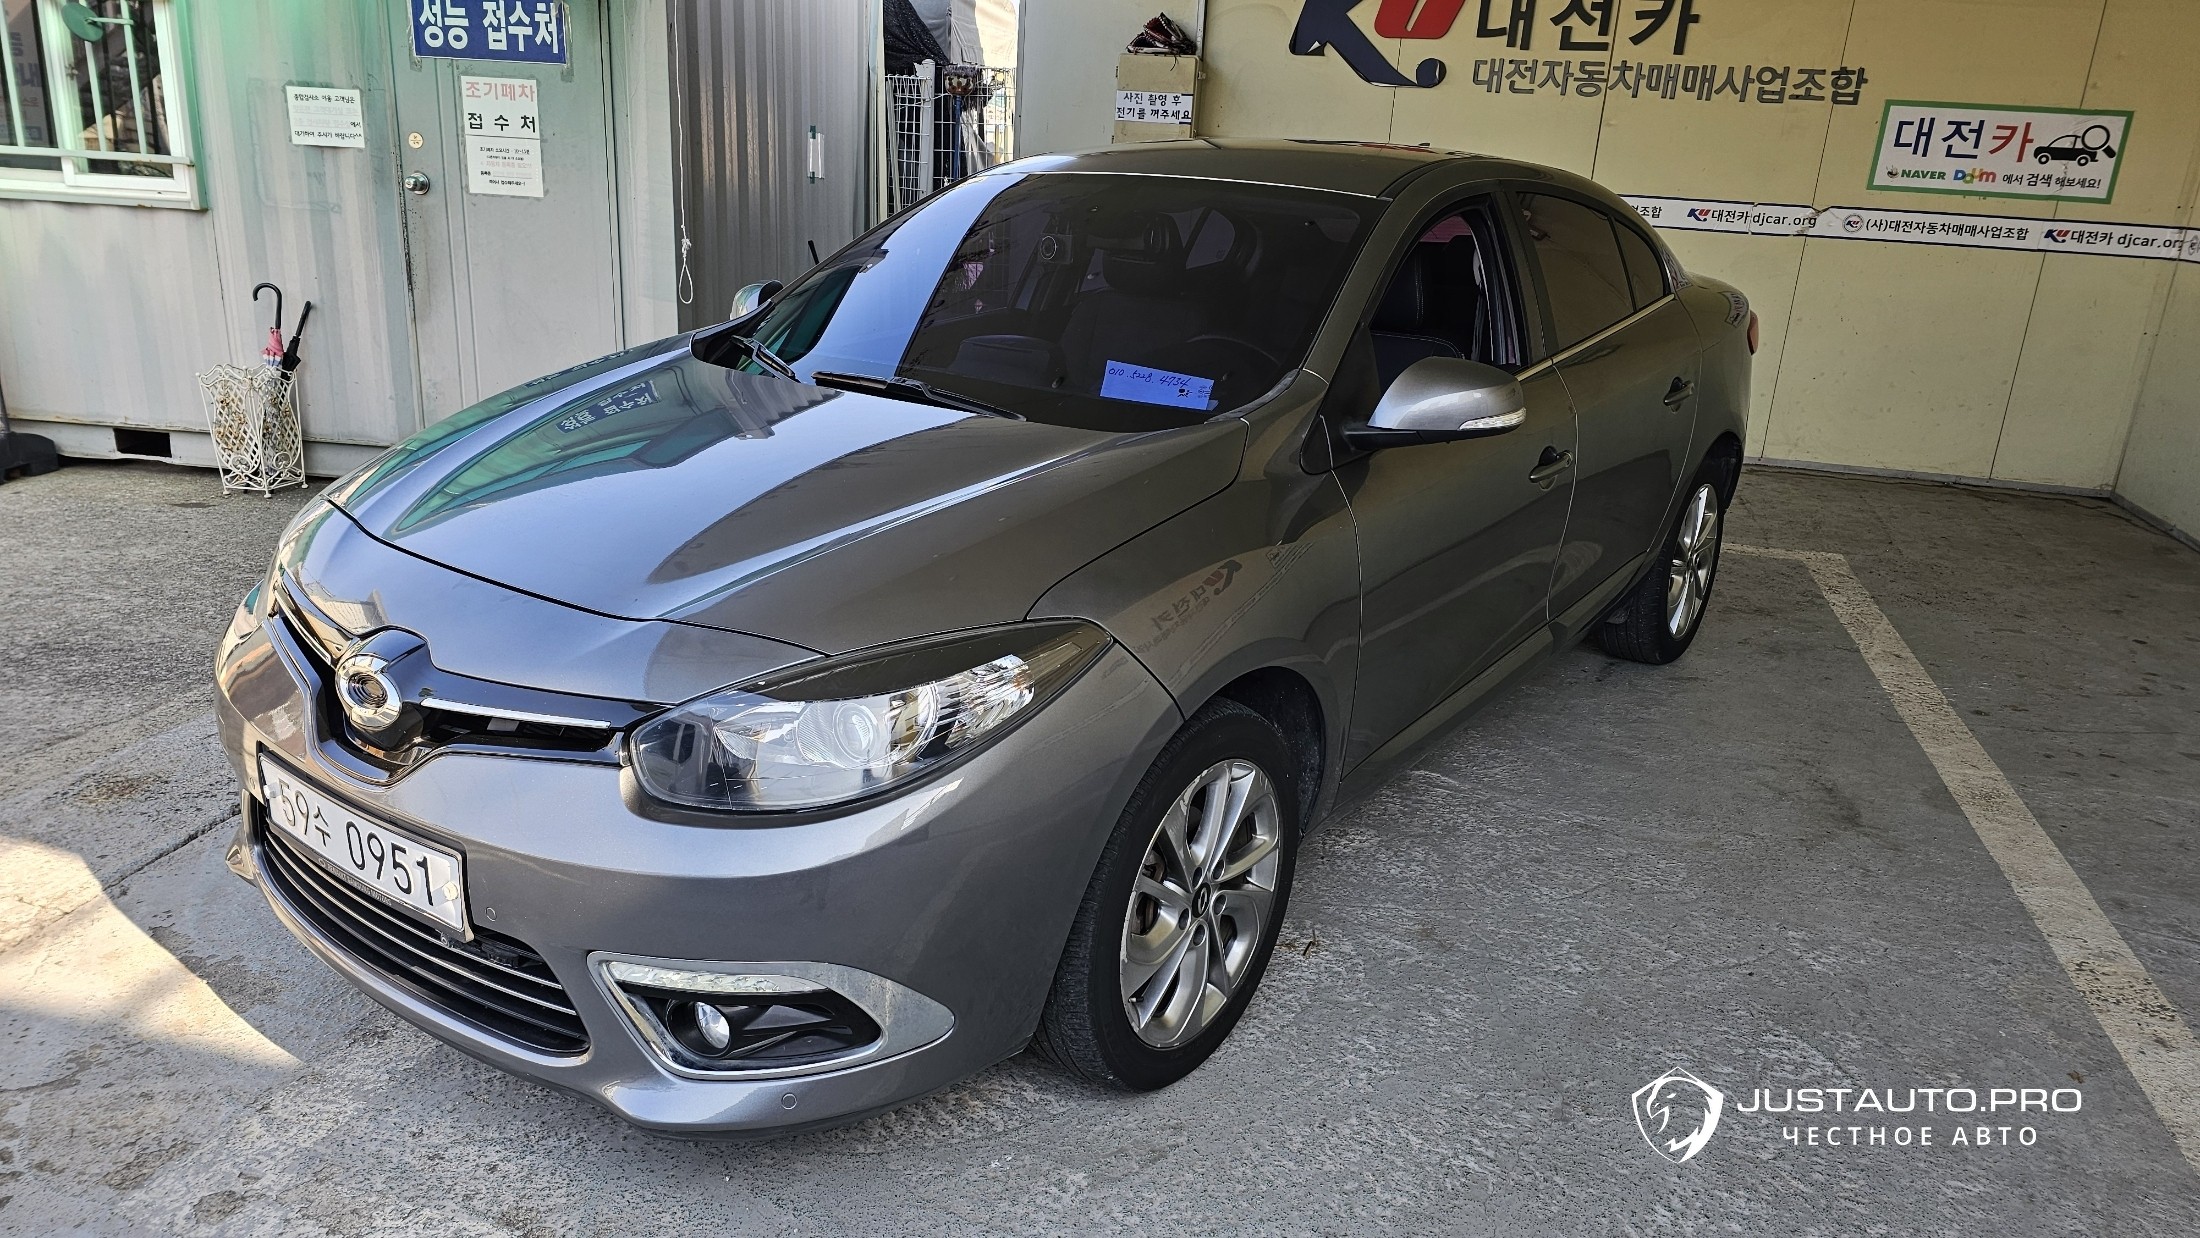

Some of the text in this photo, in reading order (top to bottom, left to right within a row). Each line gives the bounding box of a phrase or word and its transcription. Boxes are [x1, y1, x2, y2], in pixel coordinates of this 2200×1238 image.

[419, 0, 559, 54] 성능 접수처
[465, 81, 536, 102] 조기폐차
[1472, 58, 1869, 105] 대전자동차매매사업조합
[1124, 92, 1143, 105] 사진
[1171, 95, 1182, 106] 후
[1116, 107, 1192, 120] 전기를 꺼주세요
[1893, 117, 2034, 163] 대전카
[1900, 168, 1946, 181] NAVER
[2002, 174, 2024, 186] 에서
[2026, 173, 2053, 188] 검색
[2054, 176, 2102, 190] 해보세요!
[1711, 209, 1750, 224] 대전카
[1752, 212, 1818, 228] djcar.org
[1866, 218, 2030, 241] (사)대전자동차매매사업조합
[2070, 230, 2114, 246] 대전카
[278, 777, 434, 907] 59수 0951
